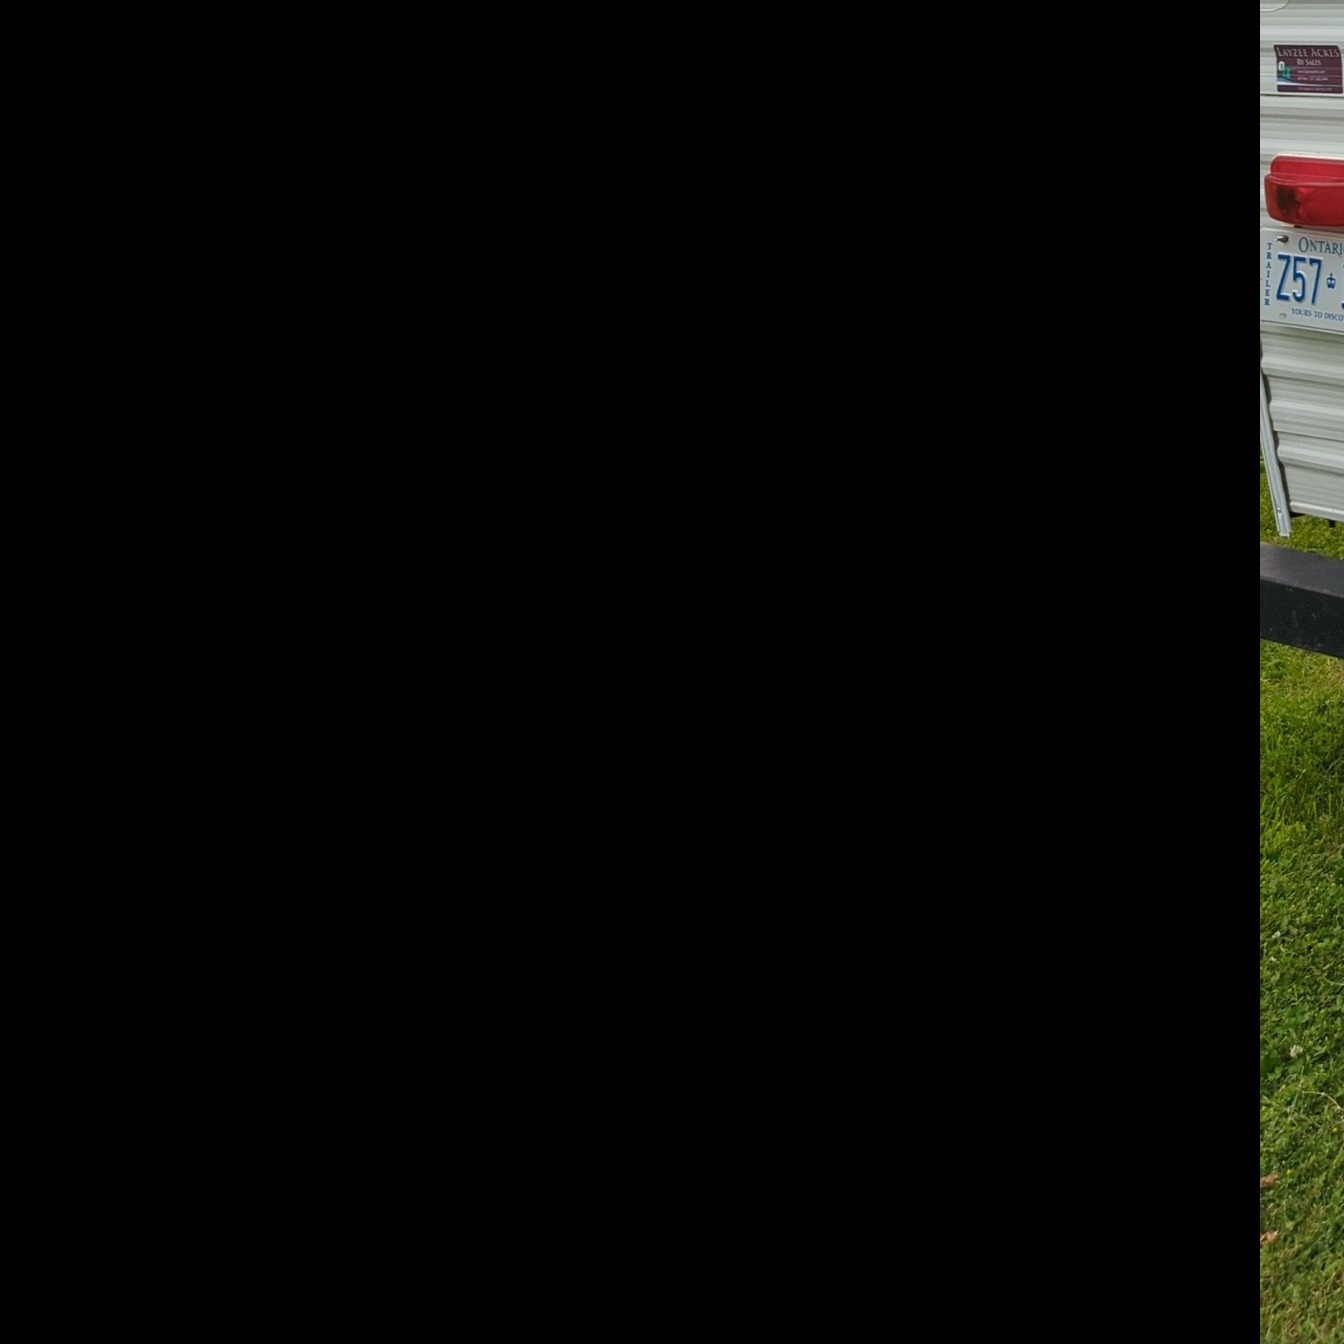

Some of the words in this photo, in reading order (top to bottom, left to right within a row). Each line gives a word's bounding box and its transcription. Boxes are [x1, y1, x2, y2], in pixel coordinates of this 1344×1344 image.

[1276, 47, 1308, 57] LAYZEE
[1311, 48, 1340, 58] ACRES
[1264, 242, 1273, 306] TRAILER
[1291, 308, 1312, 317] YOURS
[1314, 311, 1323, 319] TO
